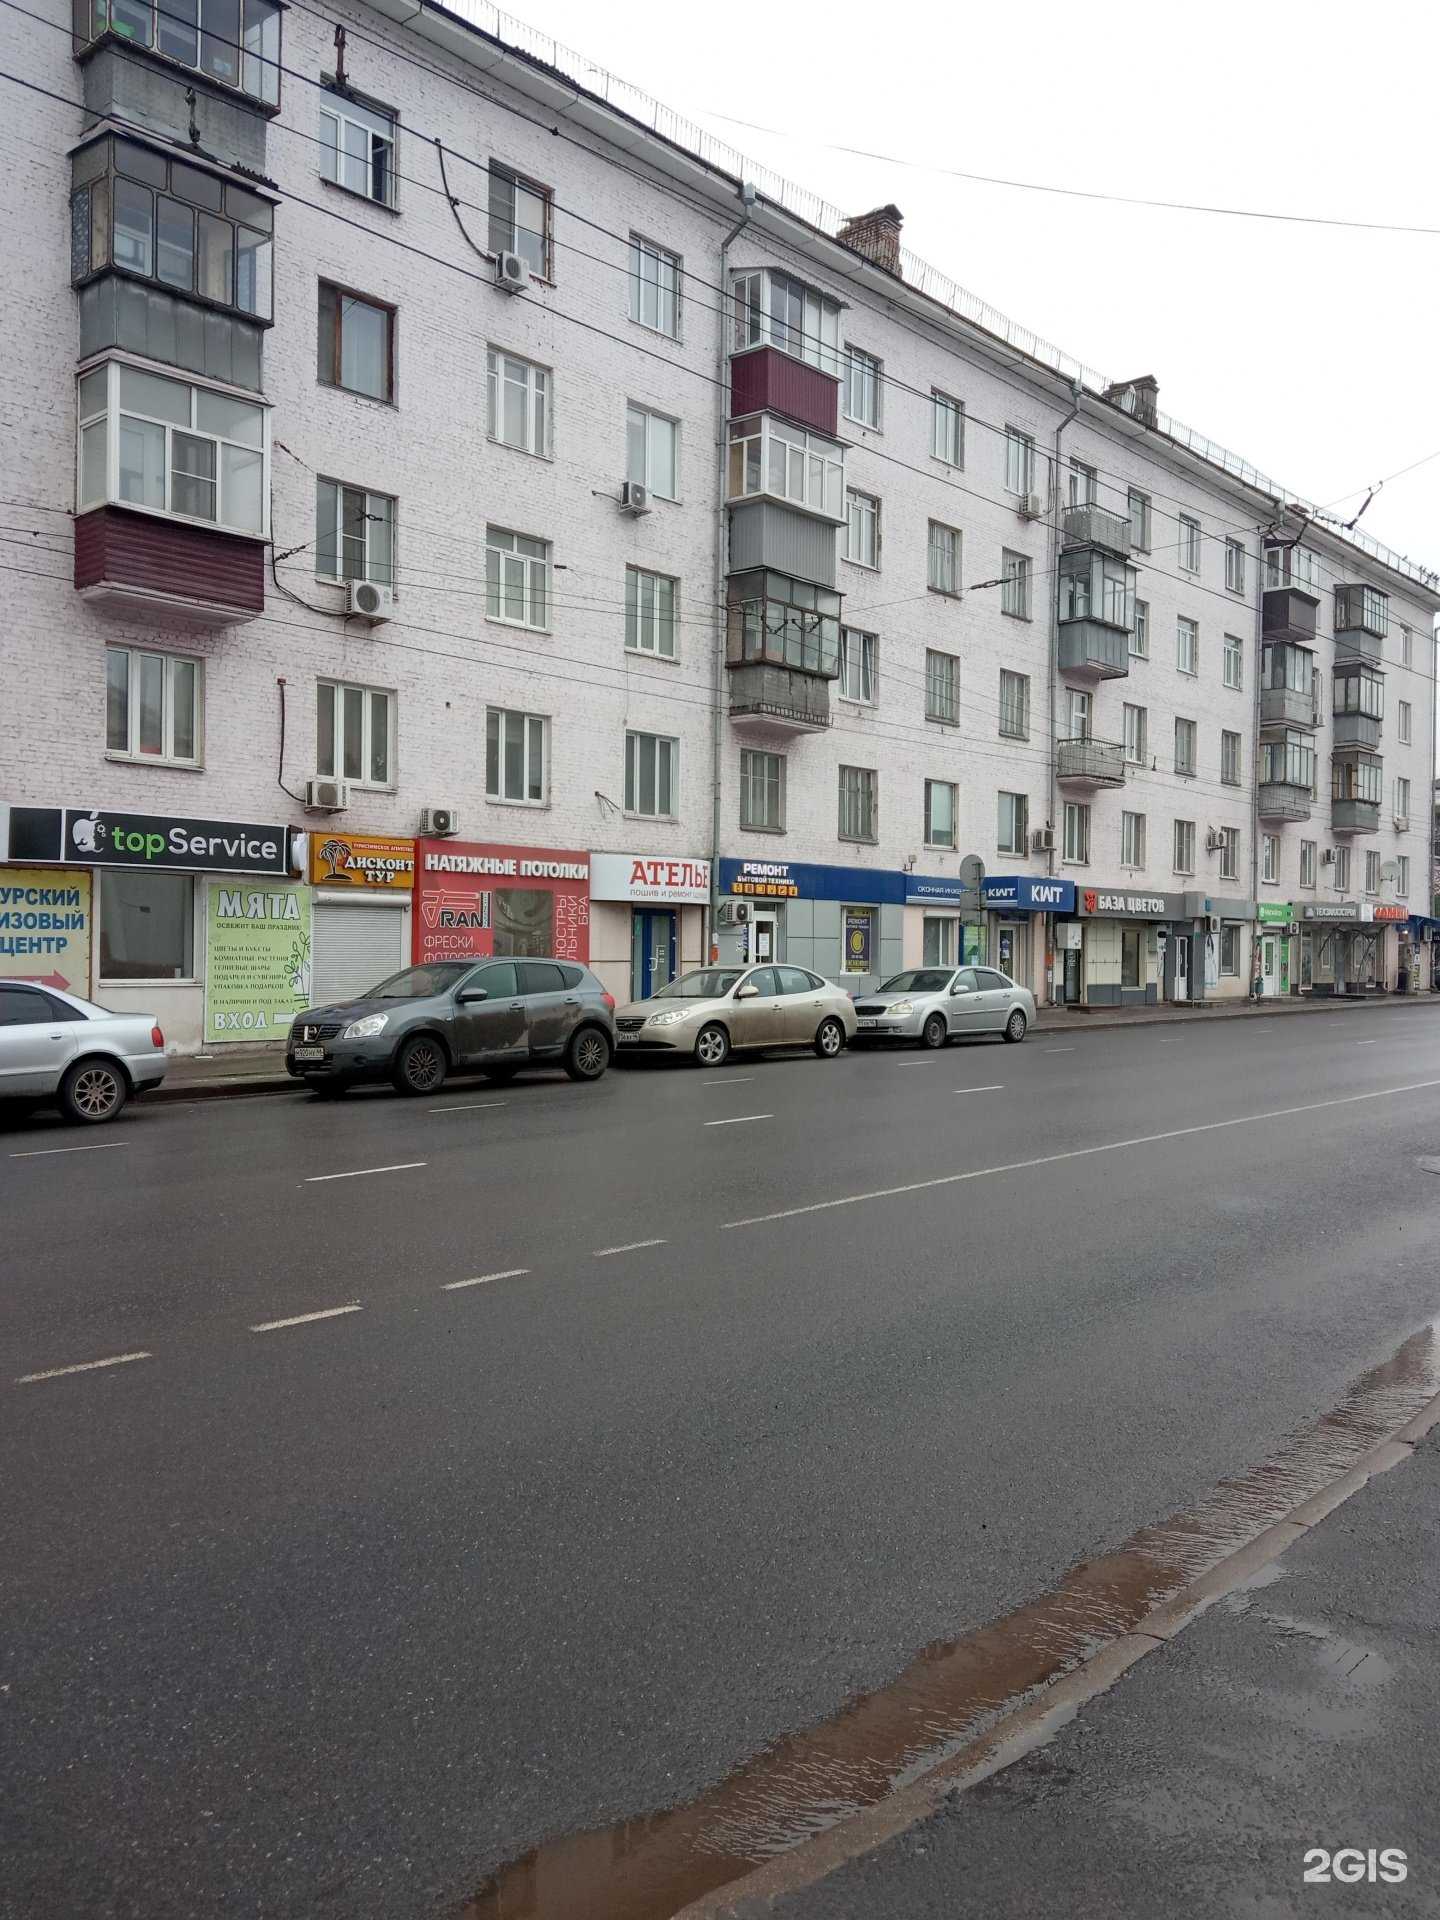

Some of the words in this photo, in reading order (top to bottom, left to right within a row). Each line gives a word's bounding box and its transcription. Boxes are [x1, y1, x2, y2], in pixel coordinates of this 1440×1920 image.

[112, 826, 277, 859] topService
[344, 856, 415, 871] ДИСКОНТ
[425, 853, 517, 876] НАТЯЖНЫЕ
[520, 860, 588, 880] ПОТОЛКИ
[743, 862, 789, 877] РЕМОНТ
[365, 870, 395, 883] ТУР
[629, 860, 708, 889] АТЕЛЬЕ
[737, 875, 767, 883] БЫТОВОЙ
[630, 889, 659, 897] пошив
[216, 889, 301, 920] МЯТА
[578, 895, 589, 925] БРА
[1097, 895, 1126, 911] БАЗА
[1126, 897, 1165, 914] ЦВЕТОВ
[566, 895, 578, 960] ЛЬНИКИ
[0, 937, 68, 956] ЦЕНТР
[424, 935, 474, 949] ФРЕСКИ
[213, 1011, 268, 1030] ВХОД
